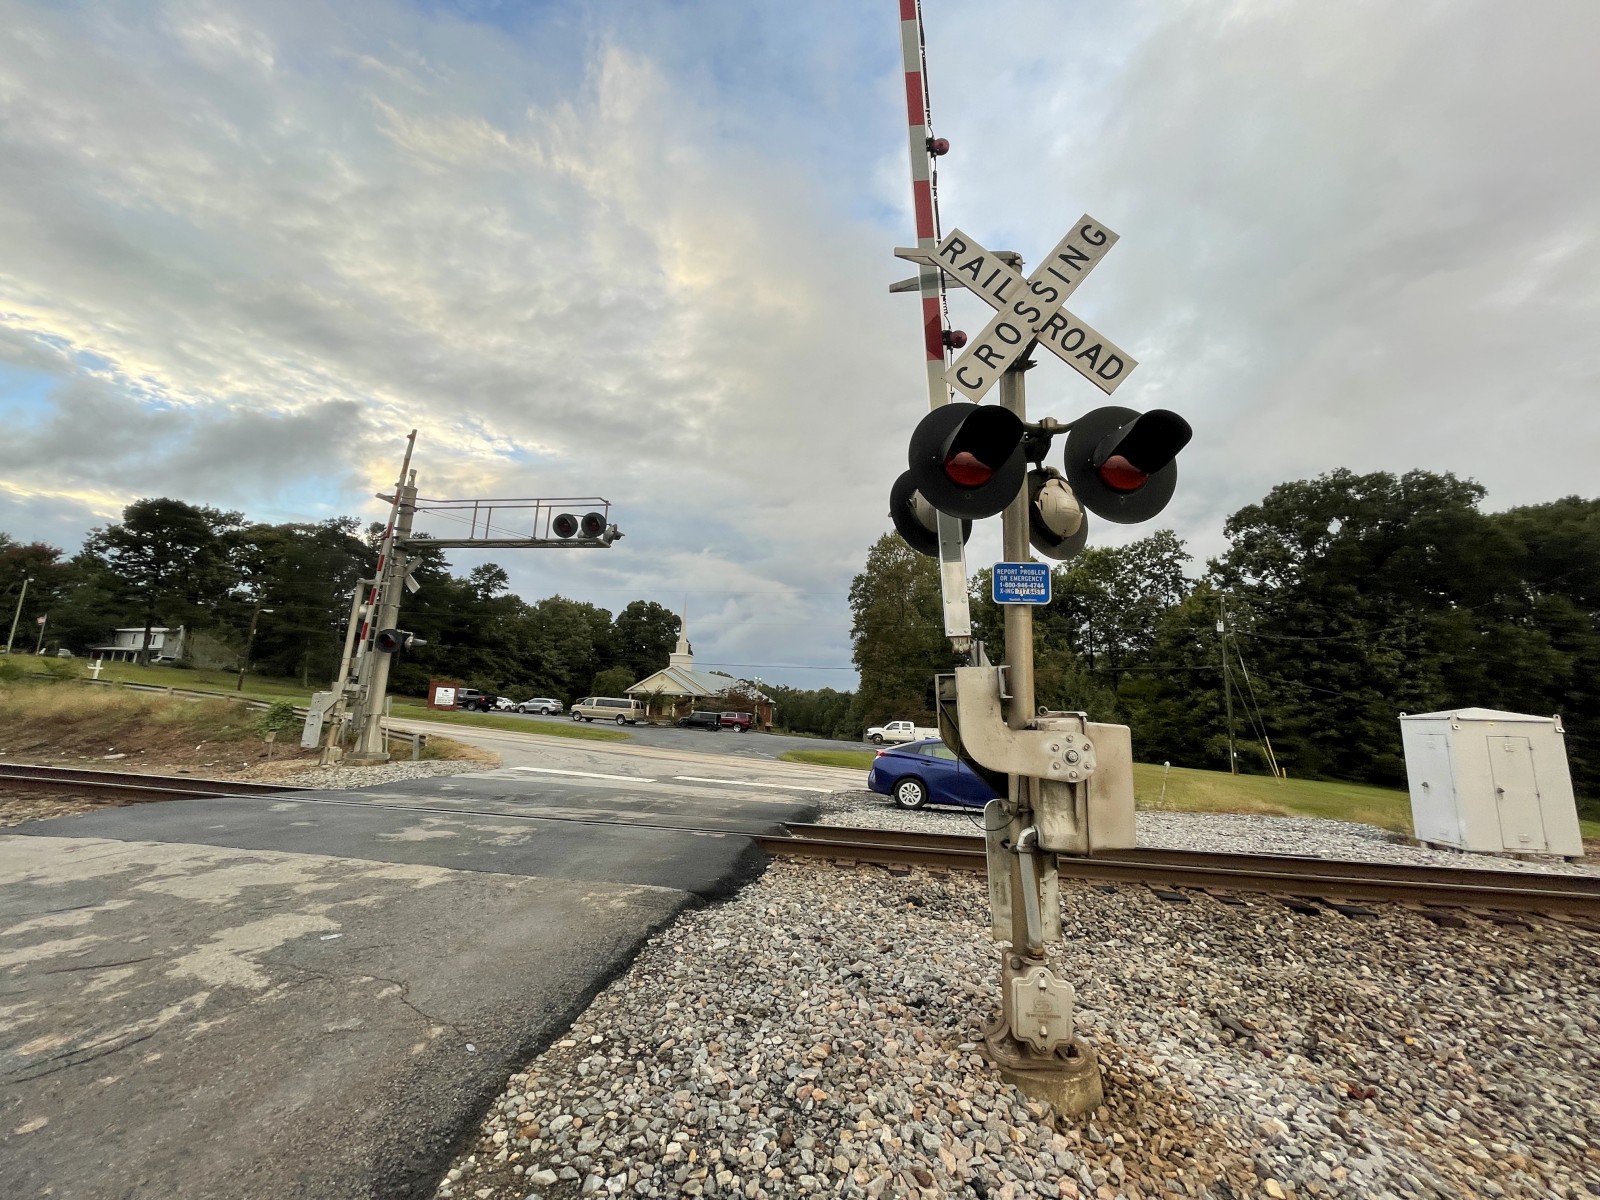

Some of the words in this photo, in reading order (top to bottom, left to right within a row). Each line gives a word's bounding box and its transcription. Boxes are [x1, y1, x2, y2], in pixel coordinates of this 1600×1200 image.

[939, 237, 1013, 304] RAIL
[1040, 312, 1124, 380] ROAD
[956, 225, 1107, 390] CROSSING
